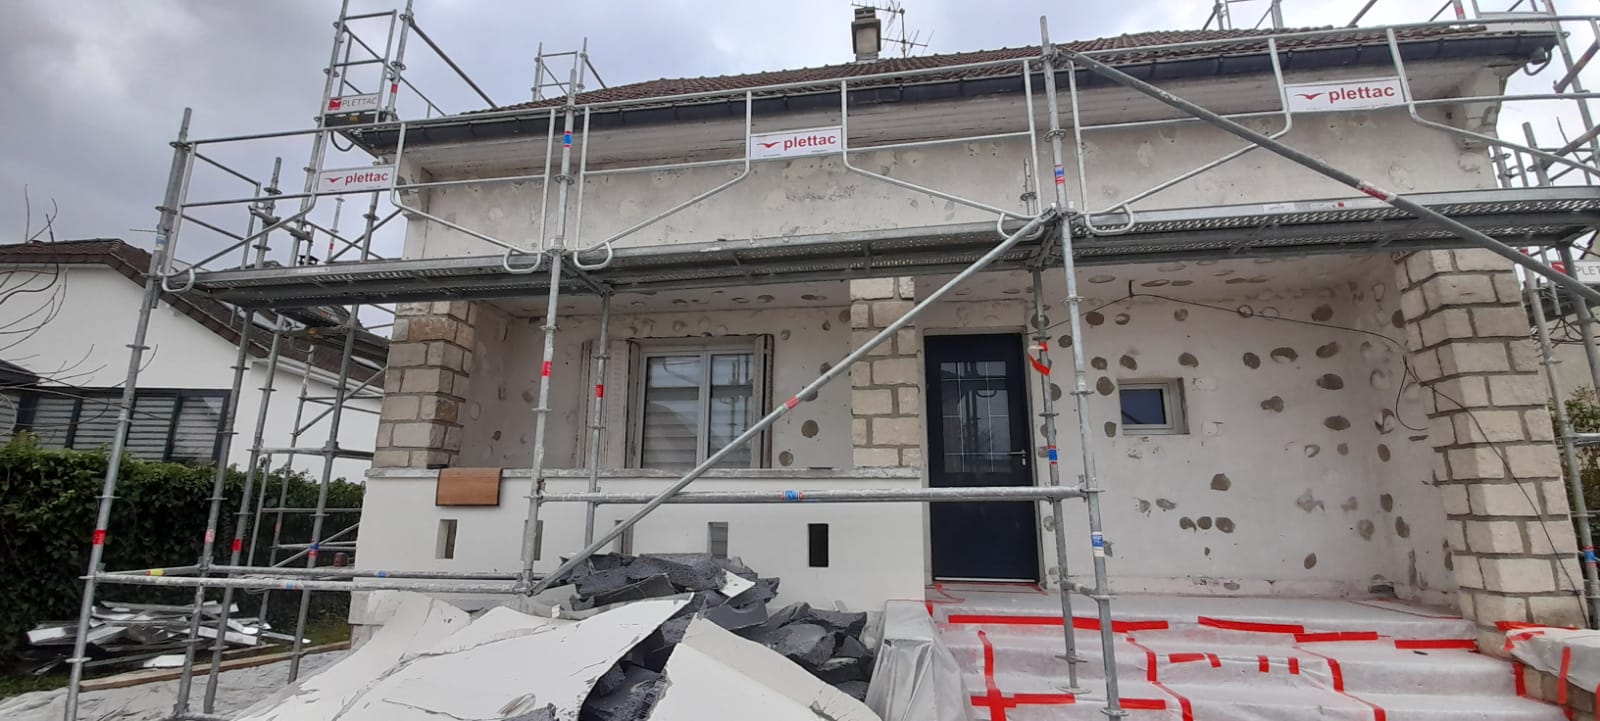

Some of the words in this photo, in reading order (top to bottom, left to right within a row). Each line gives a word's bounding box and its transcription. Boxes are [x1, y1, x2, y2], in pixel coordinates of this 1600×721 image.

[341, 97, 377, 107] PLETTAC
[1328, 86, 1395, 104] plettac
[783, 135, 836, 151] plettac
[345, 172, 389, 185] plettac
